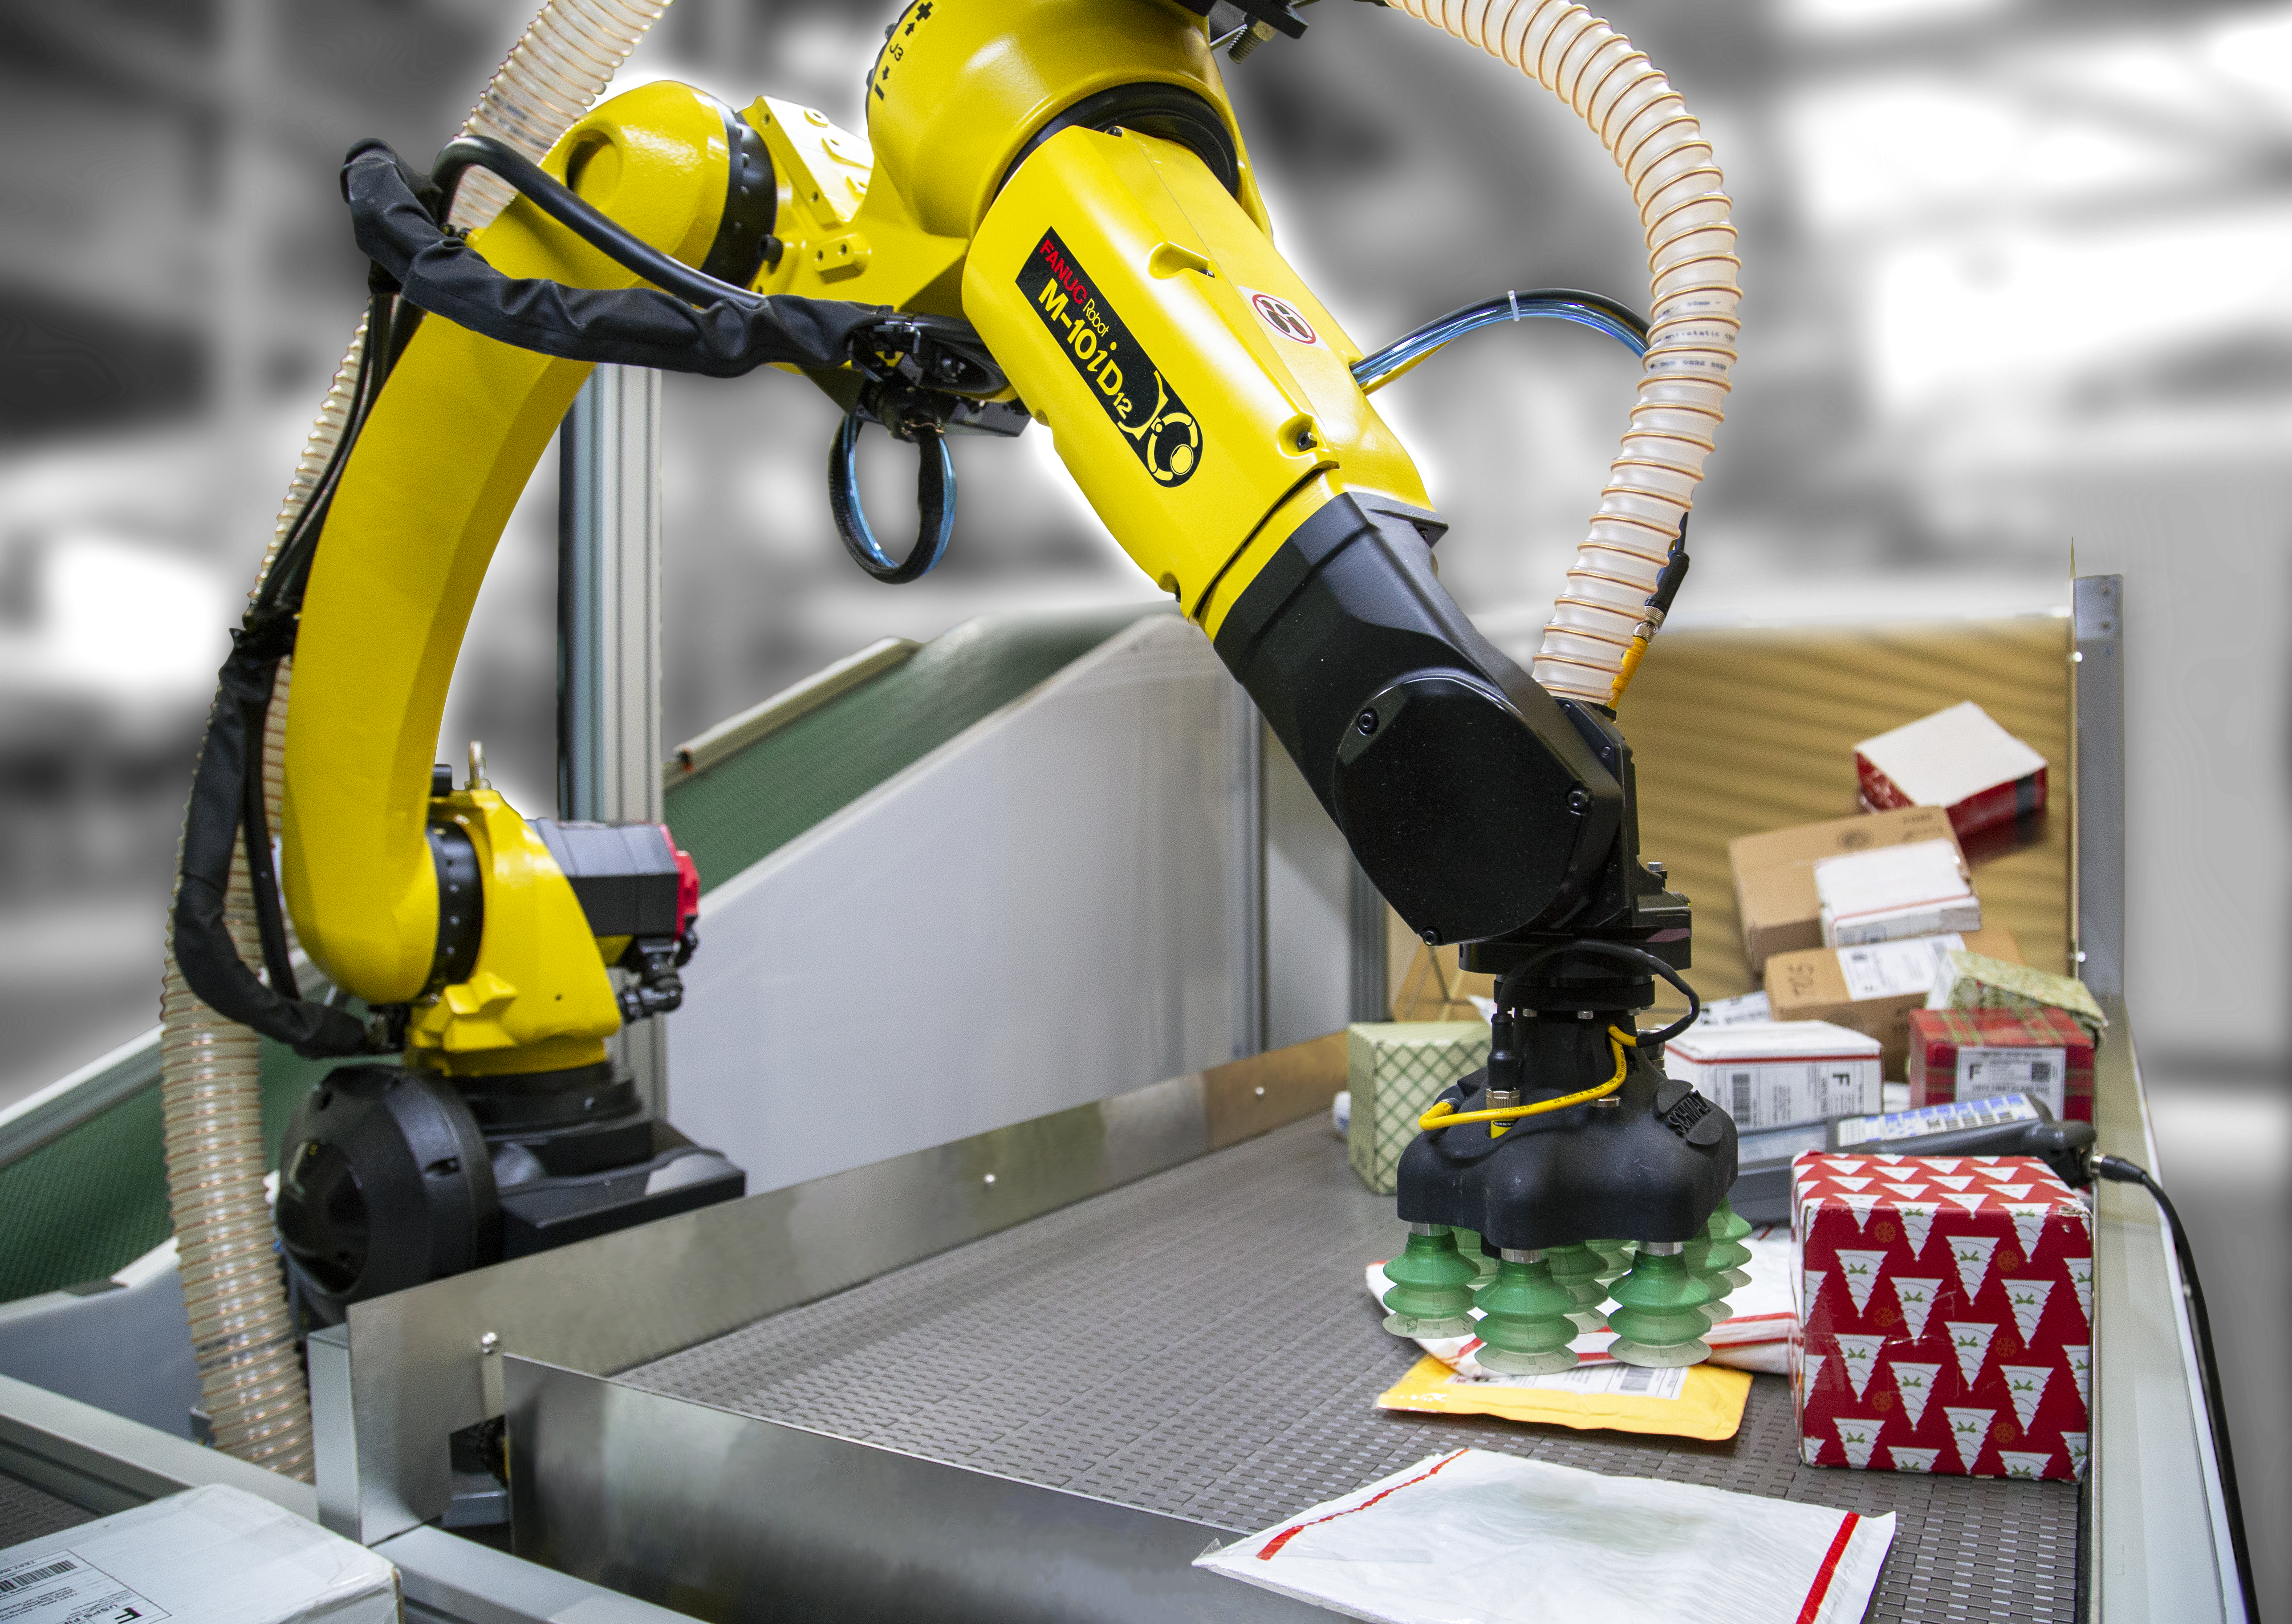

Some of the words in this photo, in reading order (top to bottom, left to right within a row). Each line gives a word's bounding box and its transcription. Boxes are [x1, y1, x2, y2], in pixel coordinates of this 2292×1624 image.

[890, 43, 903, 61] J3
[1039, 239, 1088, 305] FANUC
[1082, 298, 1109, 337] Robot
[1833, 1072, 1851, 1086] F
[1969, 1063, 1982, 1080] F
[81, 1604, 119, 1618] USPS
[114, 1607, 143, 1624] F
